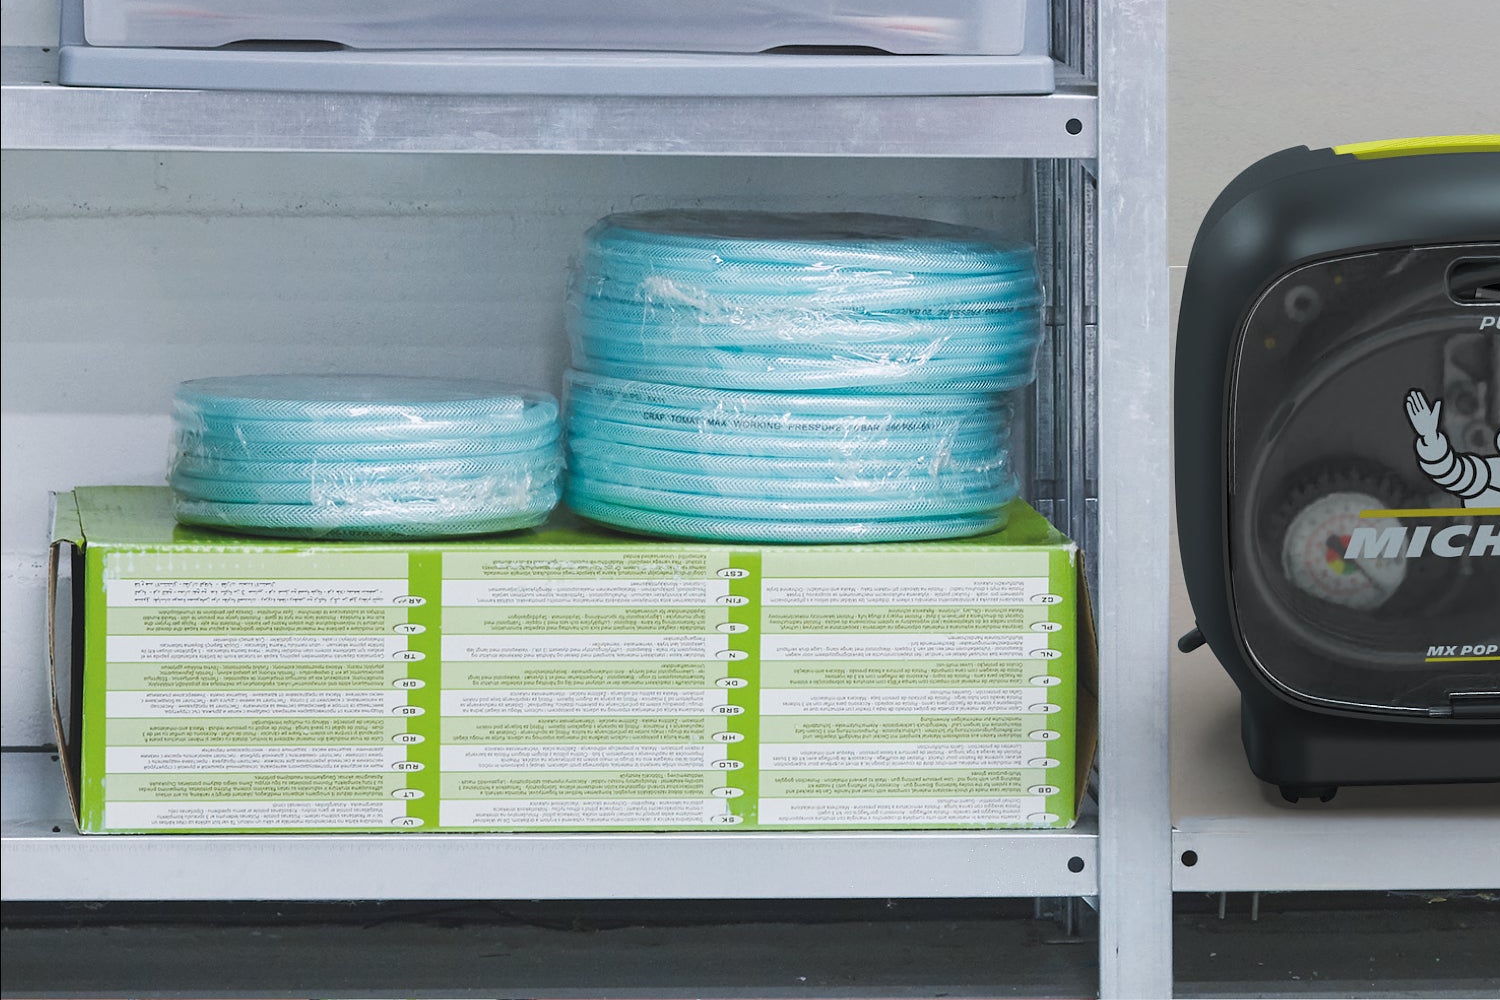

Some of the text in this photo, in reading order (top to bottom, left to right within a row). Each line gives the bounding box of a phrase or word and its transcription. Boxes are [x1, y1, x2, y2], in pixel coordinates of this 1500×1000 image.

[733, 420, 780, 430] WORKING
[1426, 645, 1458, 657] MX
[1460, 644, 1499, 656] POP
